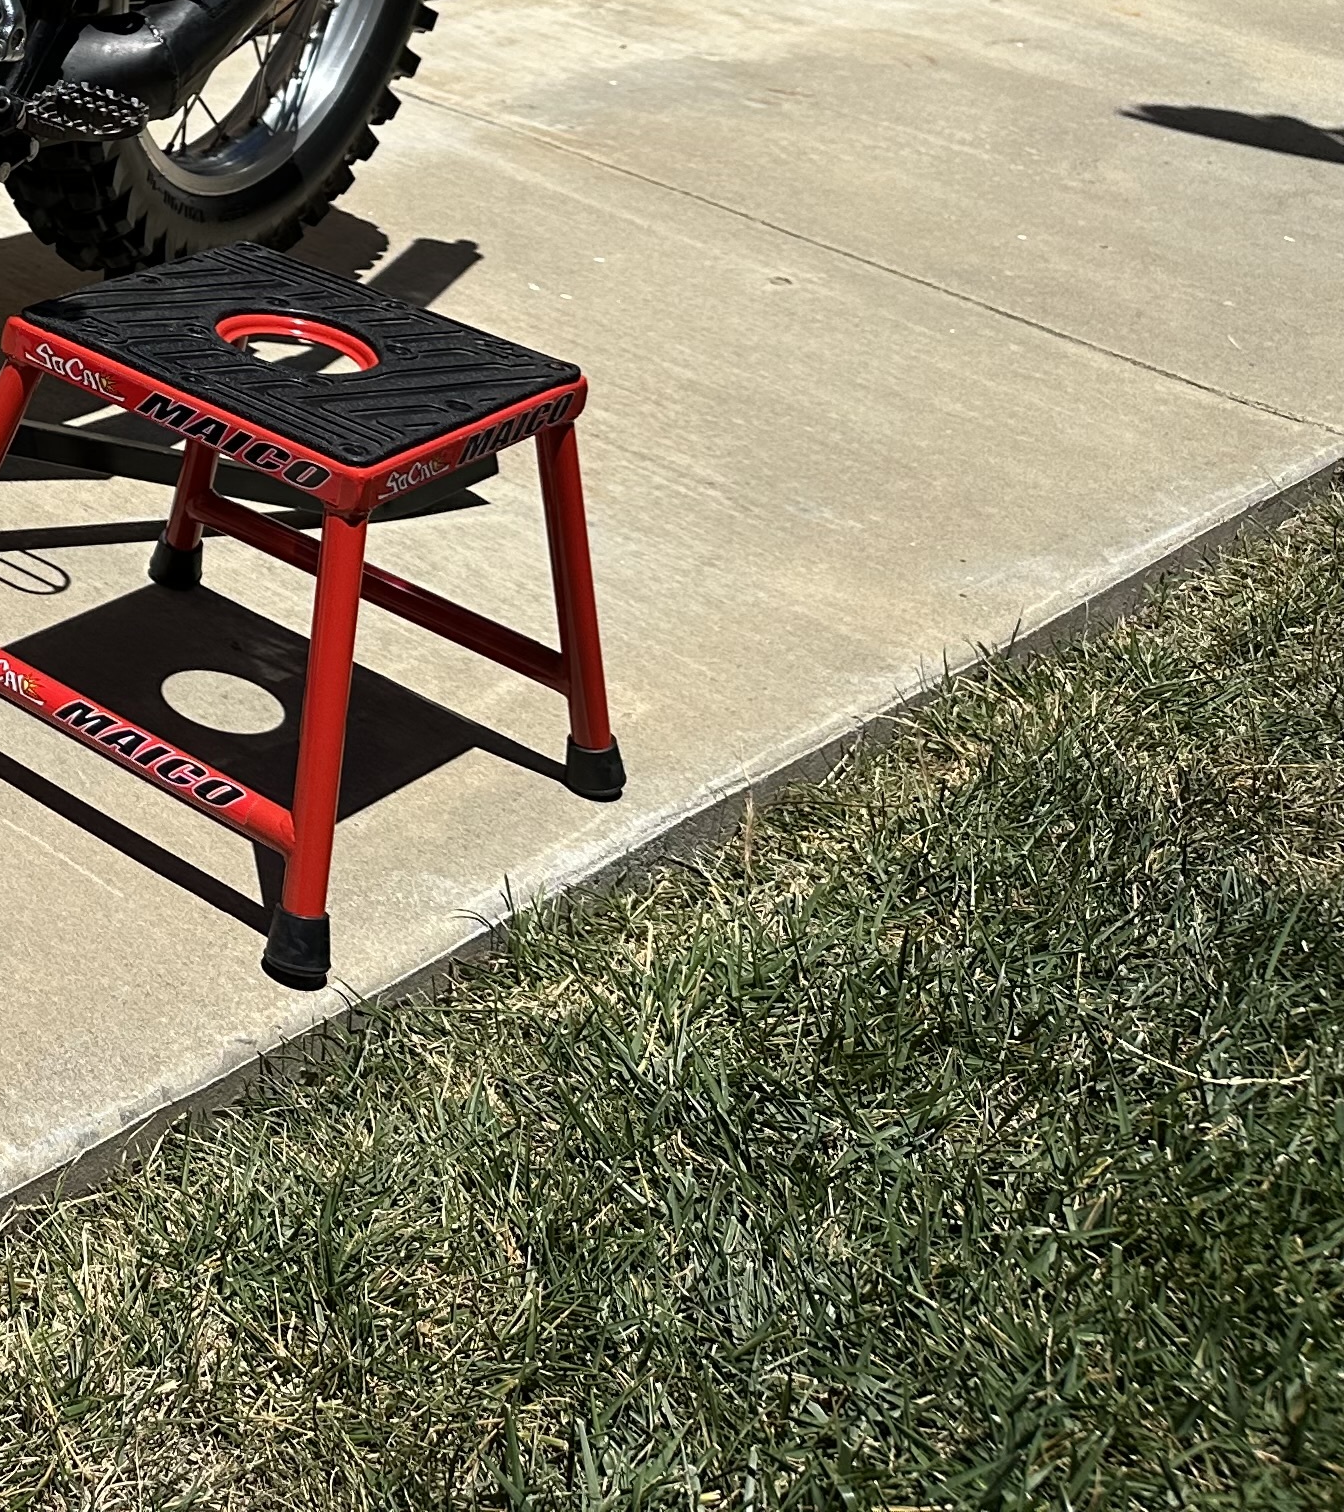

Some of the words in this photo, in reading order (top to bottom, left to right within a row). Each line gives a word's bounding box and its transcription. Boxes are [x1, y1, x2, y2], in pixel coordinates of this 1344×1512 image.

[134, 390, 332, 490] MAICO
[455, 390, 576, 467] MAICO
[51, 698, 248, 809] MAICO
